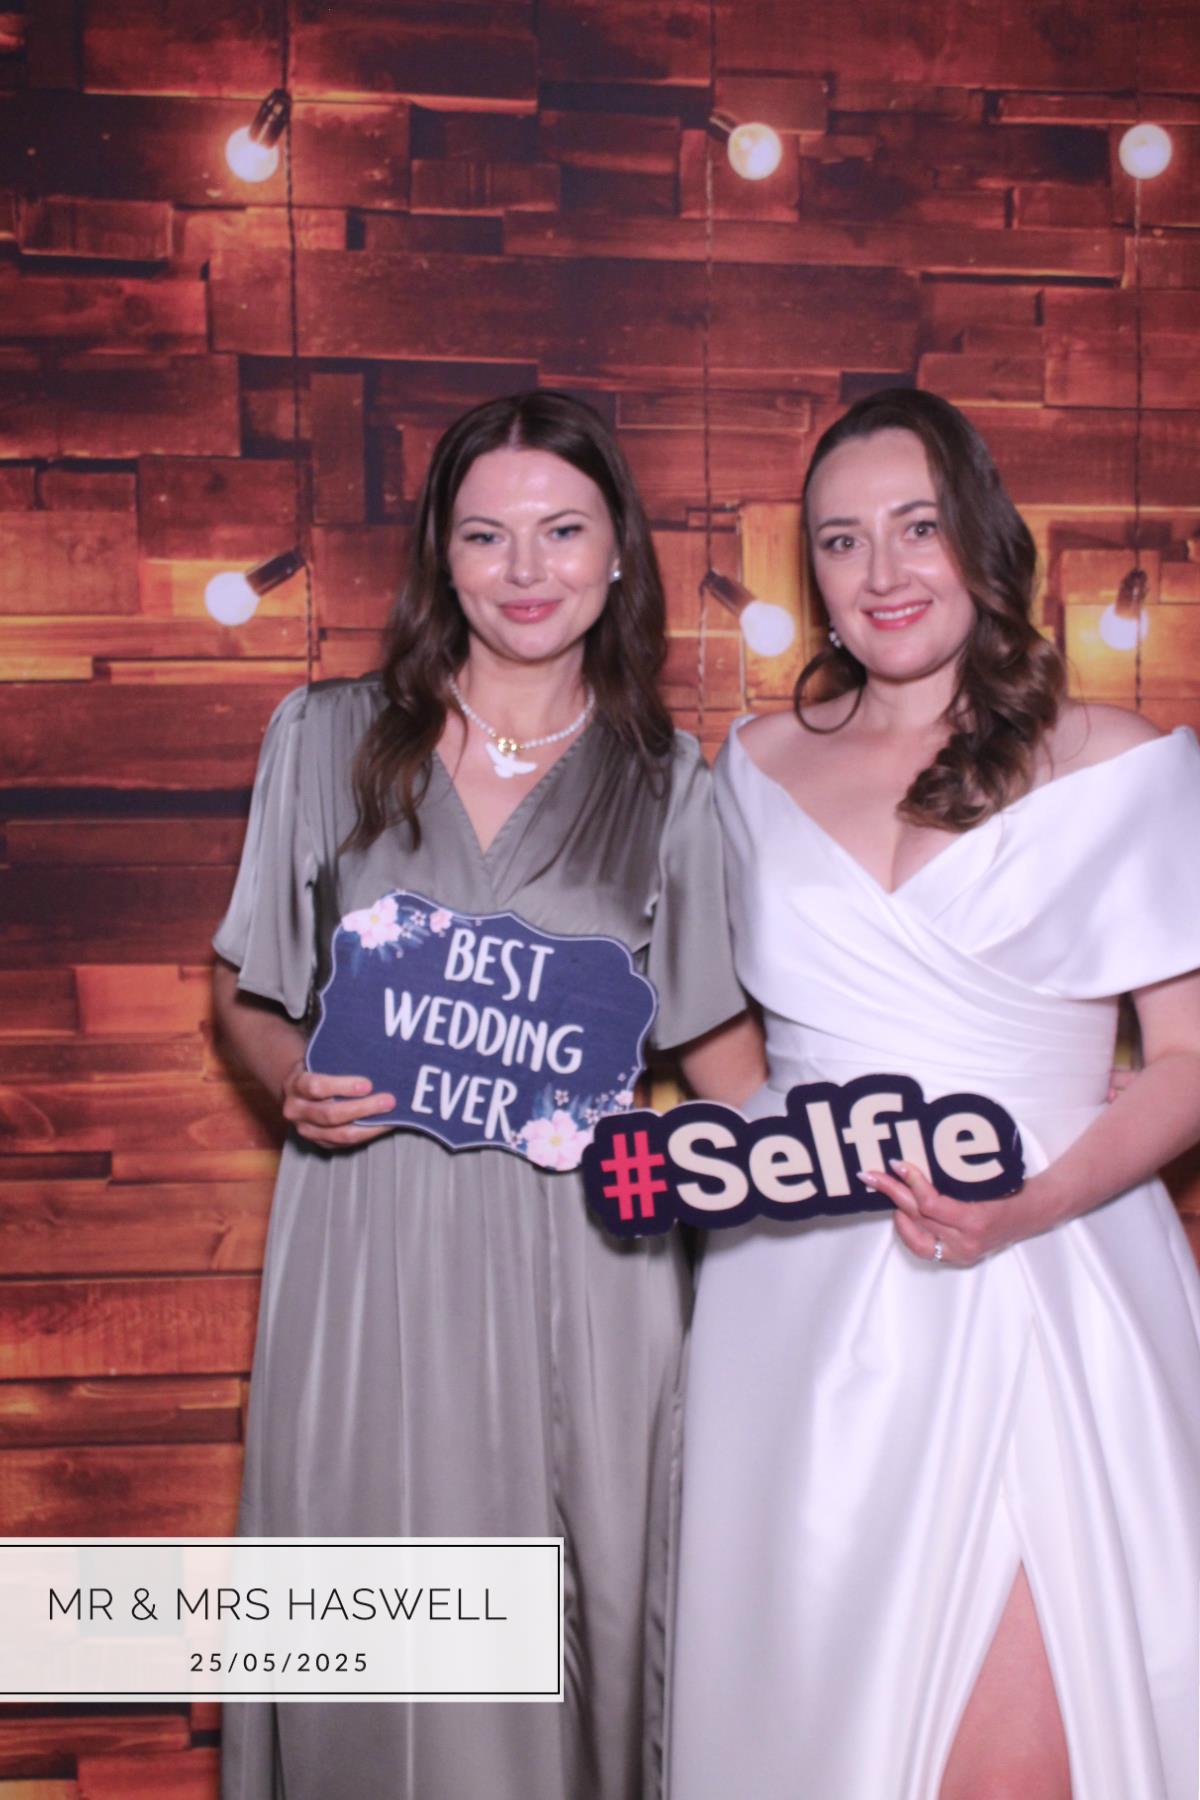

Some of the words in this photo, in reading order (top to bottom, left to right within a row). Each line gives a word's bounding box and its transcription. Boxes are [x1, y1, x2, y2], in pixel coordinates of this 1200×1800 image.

[444, 928, 554, 1002] BEST
[384, 987, 584, 1075] WEDDING
[411, 1065, 518, 1142] EVER
[600, 1092, 1005, 1221] #Selfie
